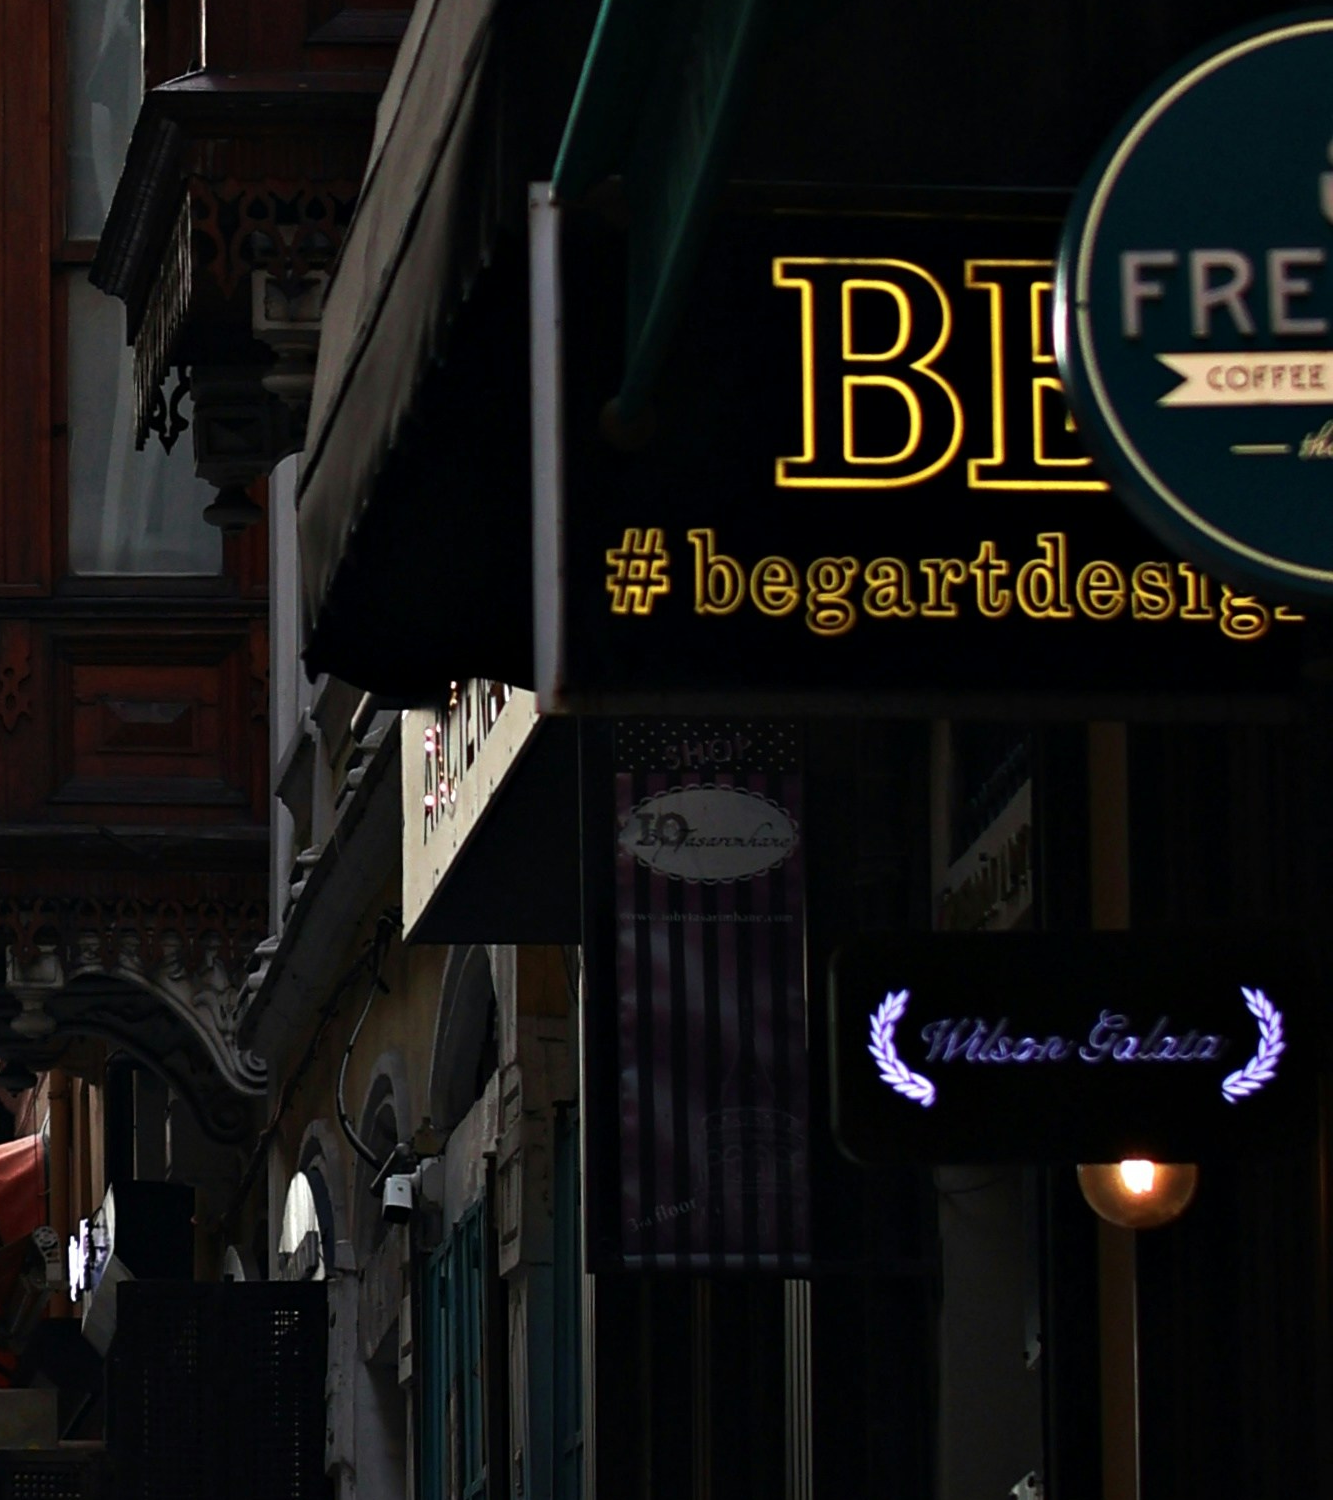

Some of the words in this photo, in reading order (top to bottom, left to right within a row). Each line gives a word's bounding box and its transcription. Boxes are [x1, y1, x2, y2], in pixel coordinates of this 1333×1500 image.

[1206, 364, 1326, 391] COFFEE
[605, 526, 1305, 640] #begartdesig
[921, 1016, 1075, 1063] Wilson
[1079, 1008, 1230, 1063] Galata
